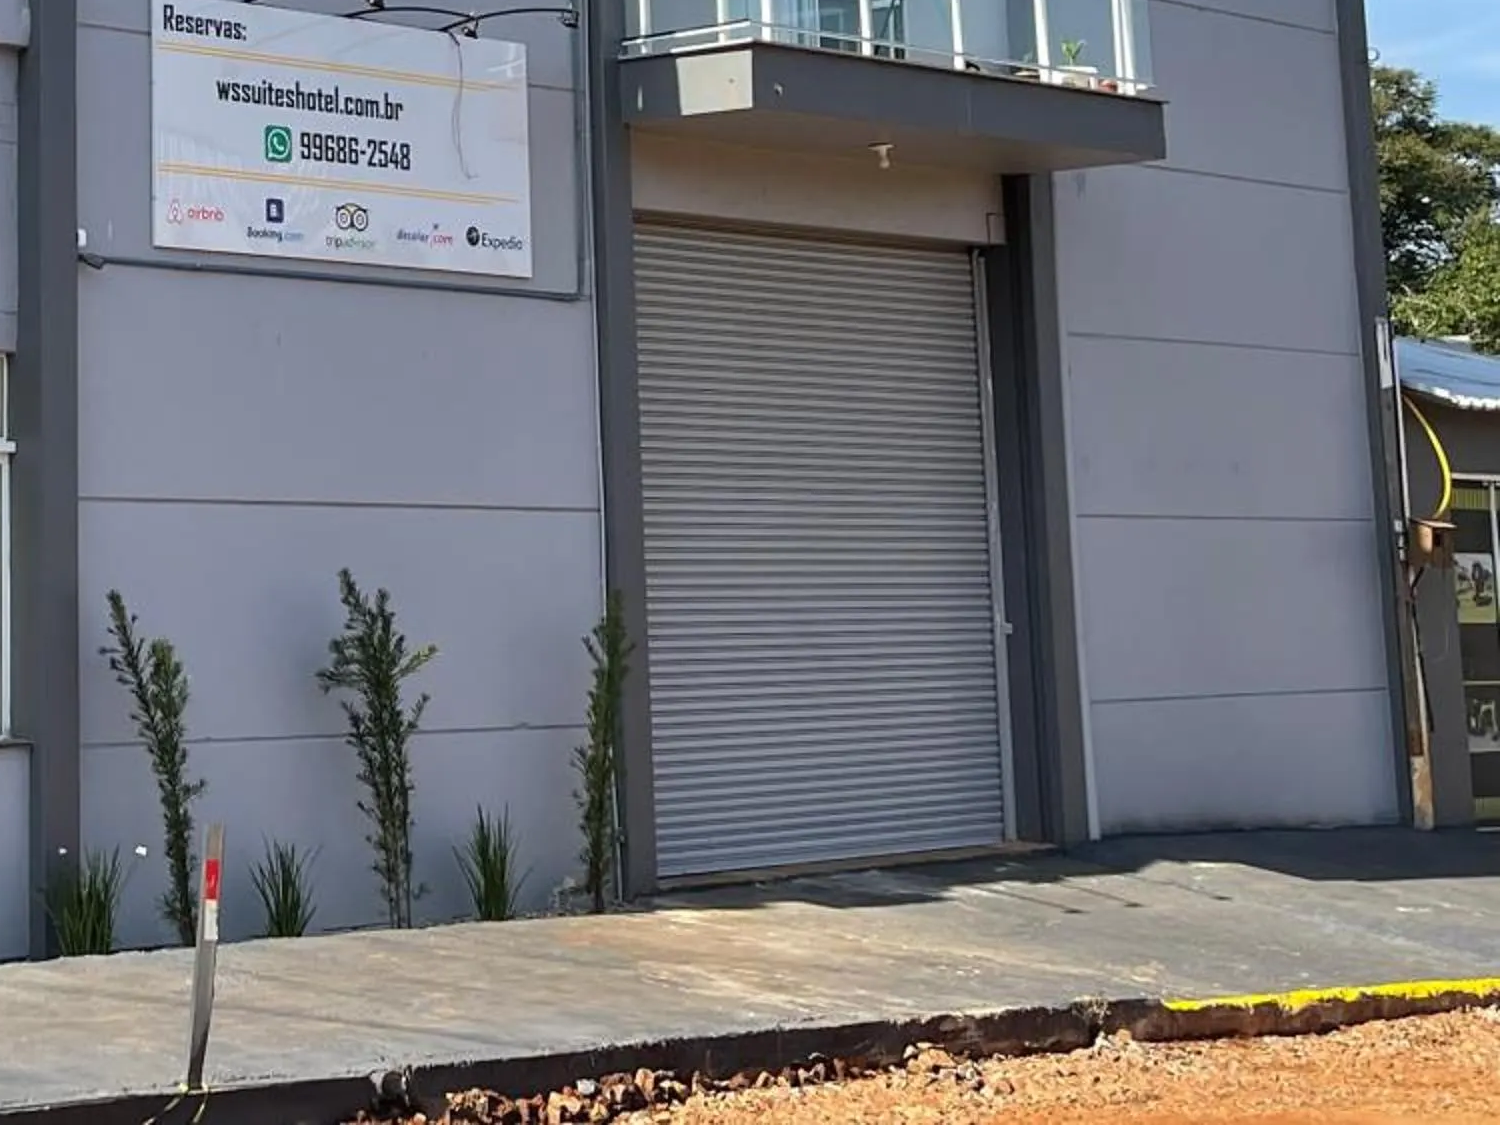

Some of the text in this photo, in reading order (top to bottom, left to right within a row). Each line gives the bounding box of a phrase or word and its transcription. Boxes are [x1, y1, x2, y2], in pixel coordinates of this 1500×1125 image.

[163, 4, 248, 42] Reservas:
[216, 79, 404, 121] wssuiteshotel.com.br
[300, 132, 411, 171] 99686-2548
[187, 206, 225, 222] airbnb
[481, 233, 523, 250] Expedia
